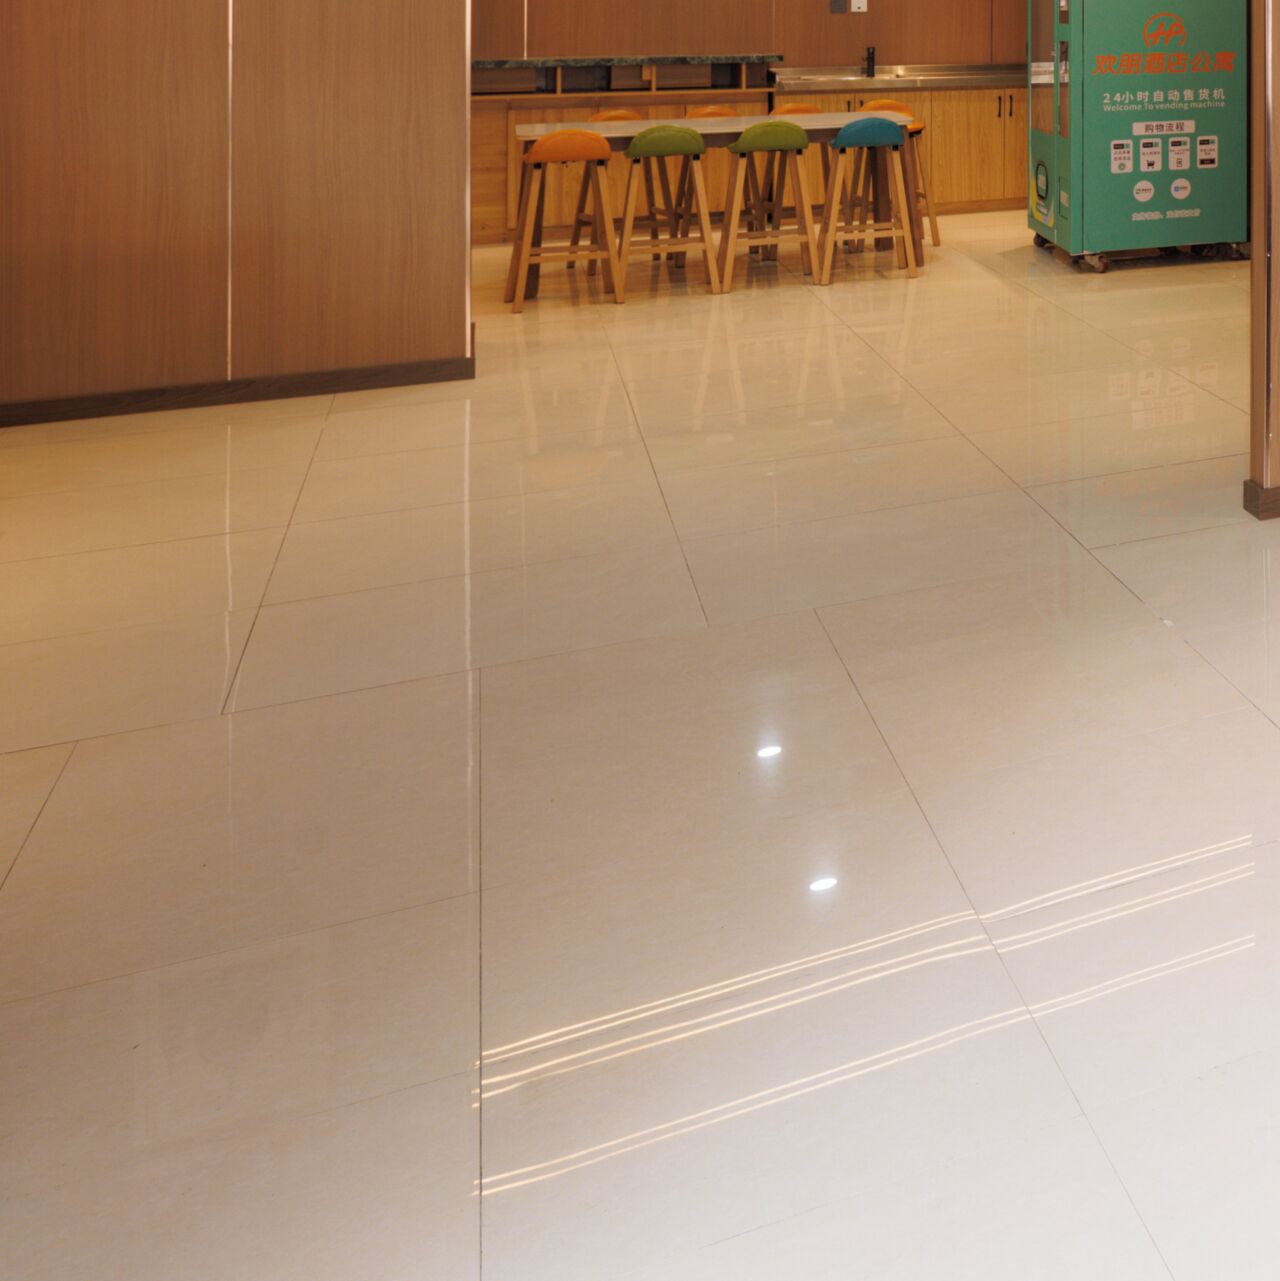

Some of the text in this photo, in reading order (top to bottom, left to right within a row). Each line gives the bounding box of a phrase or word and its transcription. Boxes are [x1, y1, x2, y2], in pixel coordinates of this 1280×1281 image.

[1092, 51, 1235, 75] 欢朋酒店公寓
[1103, 88, 1225, 103] 24小时自动售货机
[1103, 104, 1140, 112] Welcome
[1155, 101, 1189, 111] vending
[1190, 99, 1225, 109] machine
[1144, 122, 1185, 133] 购物流程
